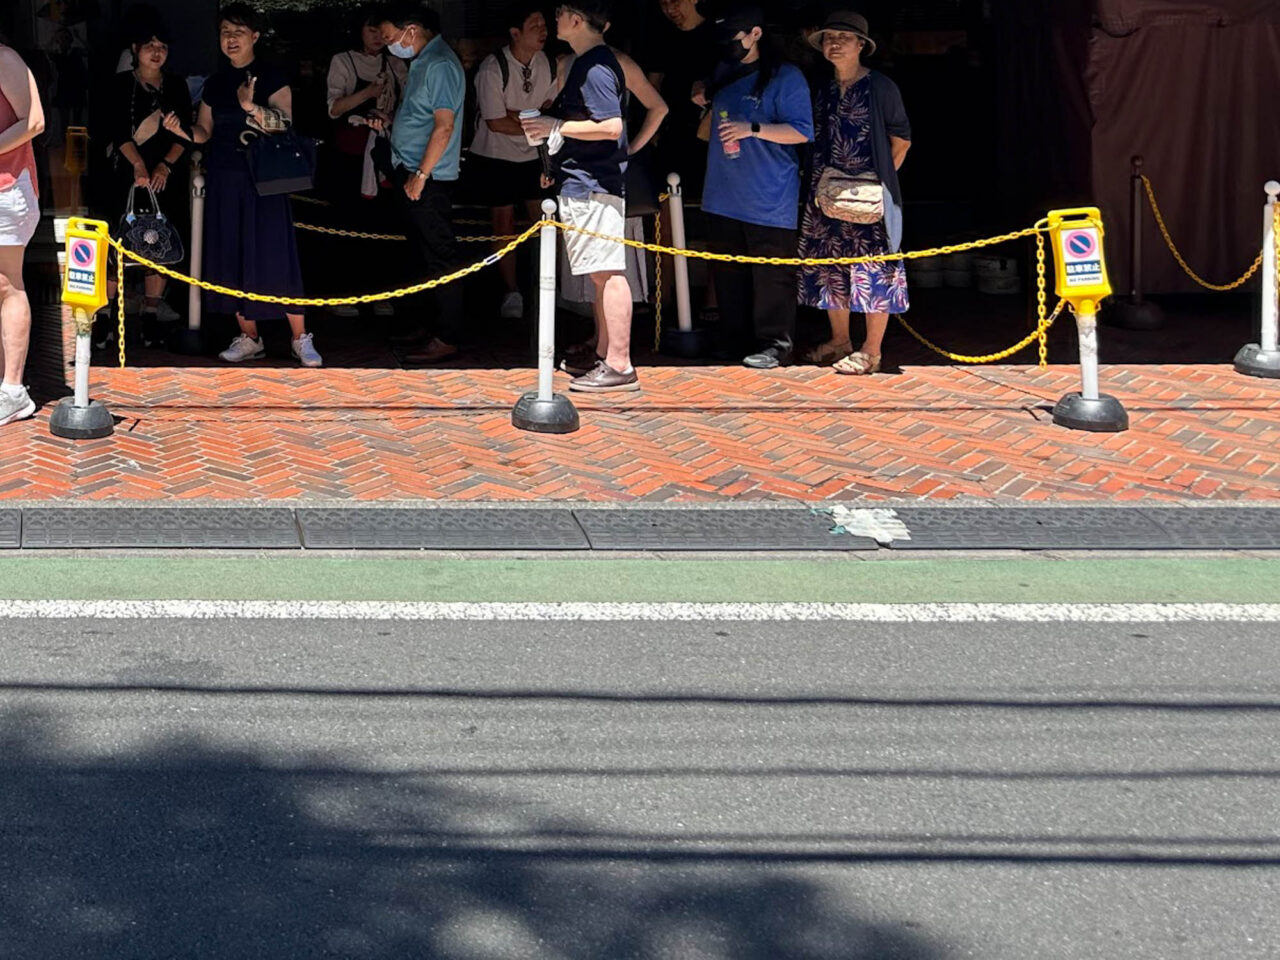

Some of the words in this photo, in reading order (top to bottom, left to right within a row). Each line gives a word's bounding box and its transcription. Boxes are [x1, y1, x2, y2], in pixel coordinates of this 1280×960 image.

[1066, 263, 1100, 273] 駐車禁止
[69, 271, 95, 282] 駐車禁止
